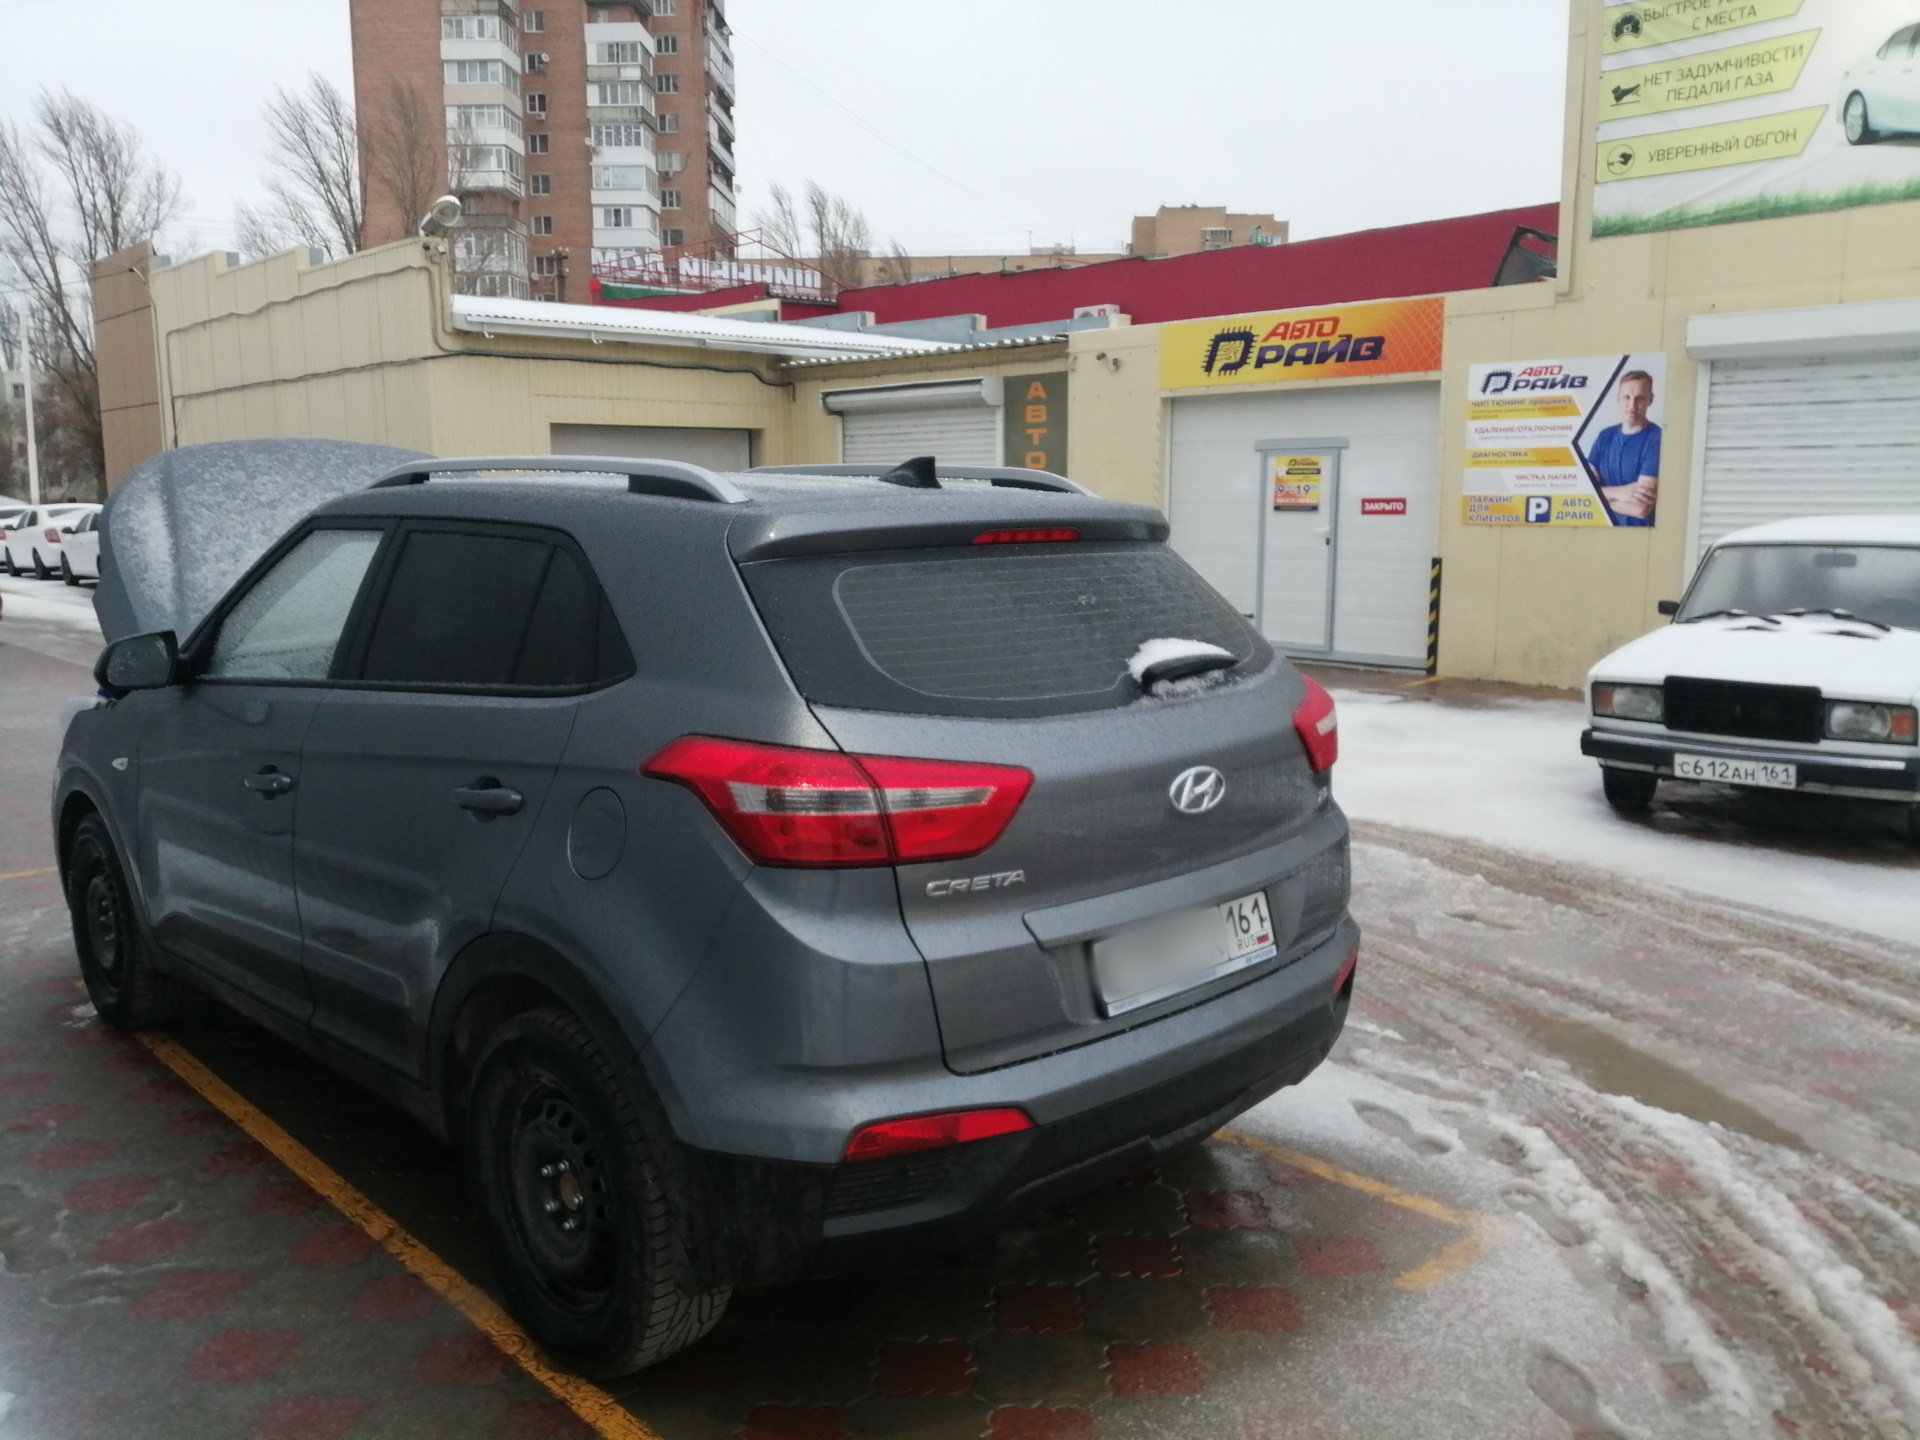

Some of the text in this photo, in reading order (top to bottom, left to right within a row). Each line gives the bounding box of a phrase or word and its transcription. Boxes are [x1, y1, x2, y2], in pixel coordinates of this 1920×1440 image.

[1643, 0, 1711, 22] БЫСТРОЕ
[1692, 5, 1757, 30] С МЕСТА
[1644, 44, 1804, 87] НЕТ ЗАДУМЧИВОСТИ
[1667, 71, 1775, 102] ПЕДАЛИ ГАЗА
[1648, 128, 1798, 163] УВЕРЕННЫЙ ОБГОН
[1261, 316, 1340, 342] АВТО
[1518, 365, 1563, 377] АВТО
[1472, 451, 1529, 459] ДИАГНОСТИКА
[1363, 502, 1404, 511] ЗАКРЫТО
[1469, 505, 1490, 513] ДЛЯ
[1470, 496, 1514, 504] ПАРКИНГ
[1562, 498, 1592, 507] АВТО
[1469, 514, 1520, 523] КЛИЕНТОВ
[1528, 497, 1549, 522] P
[1556, 510, 1594, 520] ДРАЙВ
[926, 870, 1026, 896] CRETA
[1226, 898, 1264, 938] 161
[1237, 935, 1257, 950] RUS
